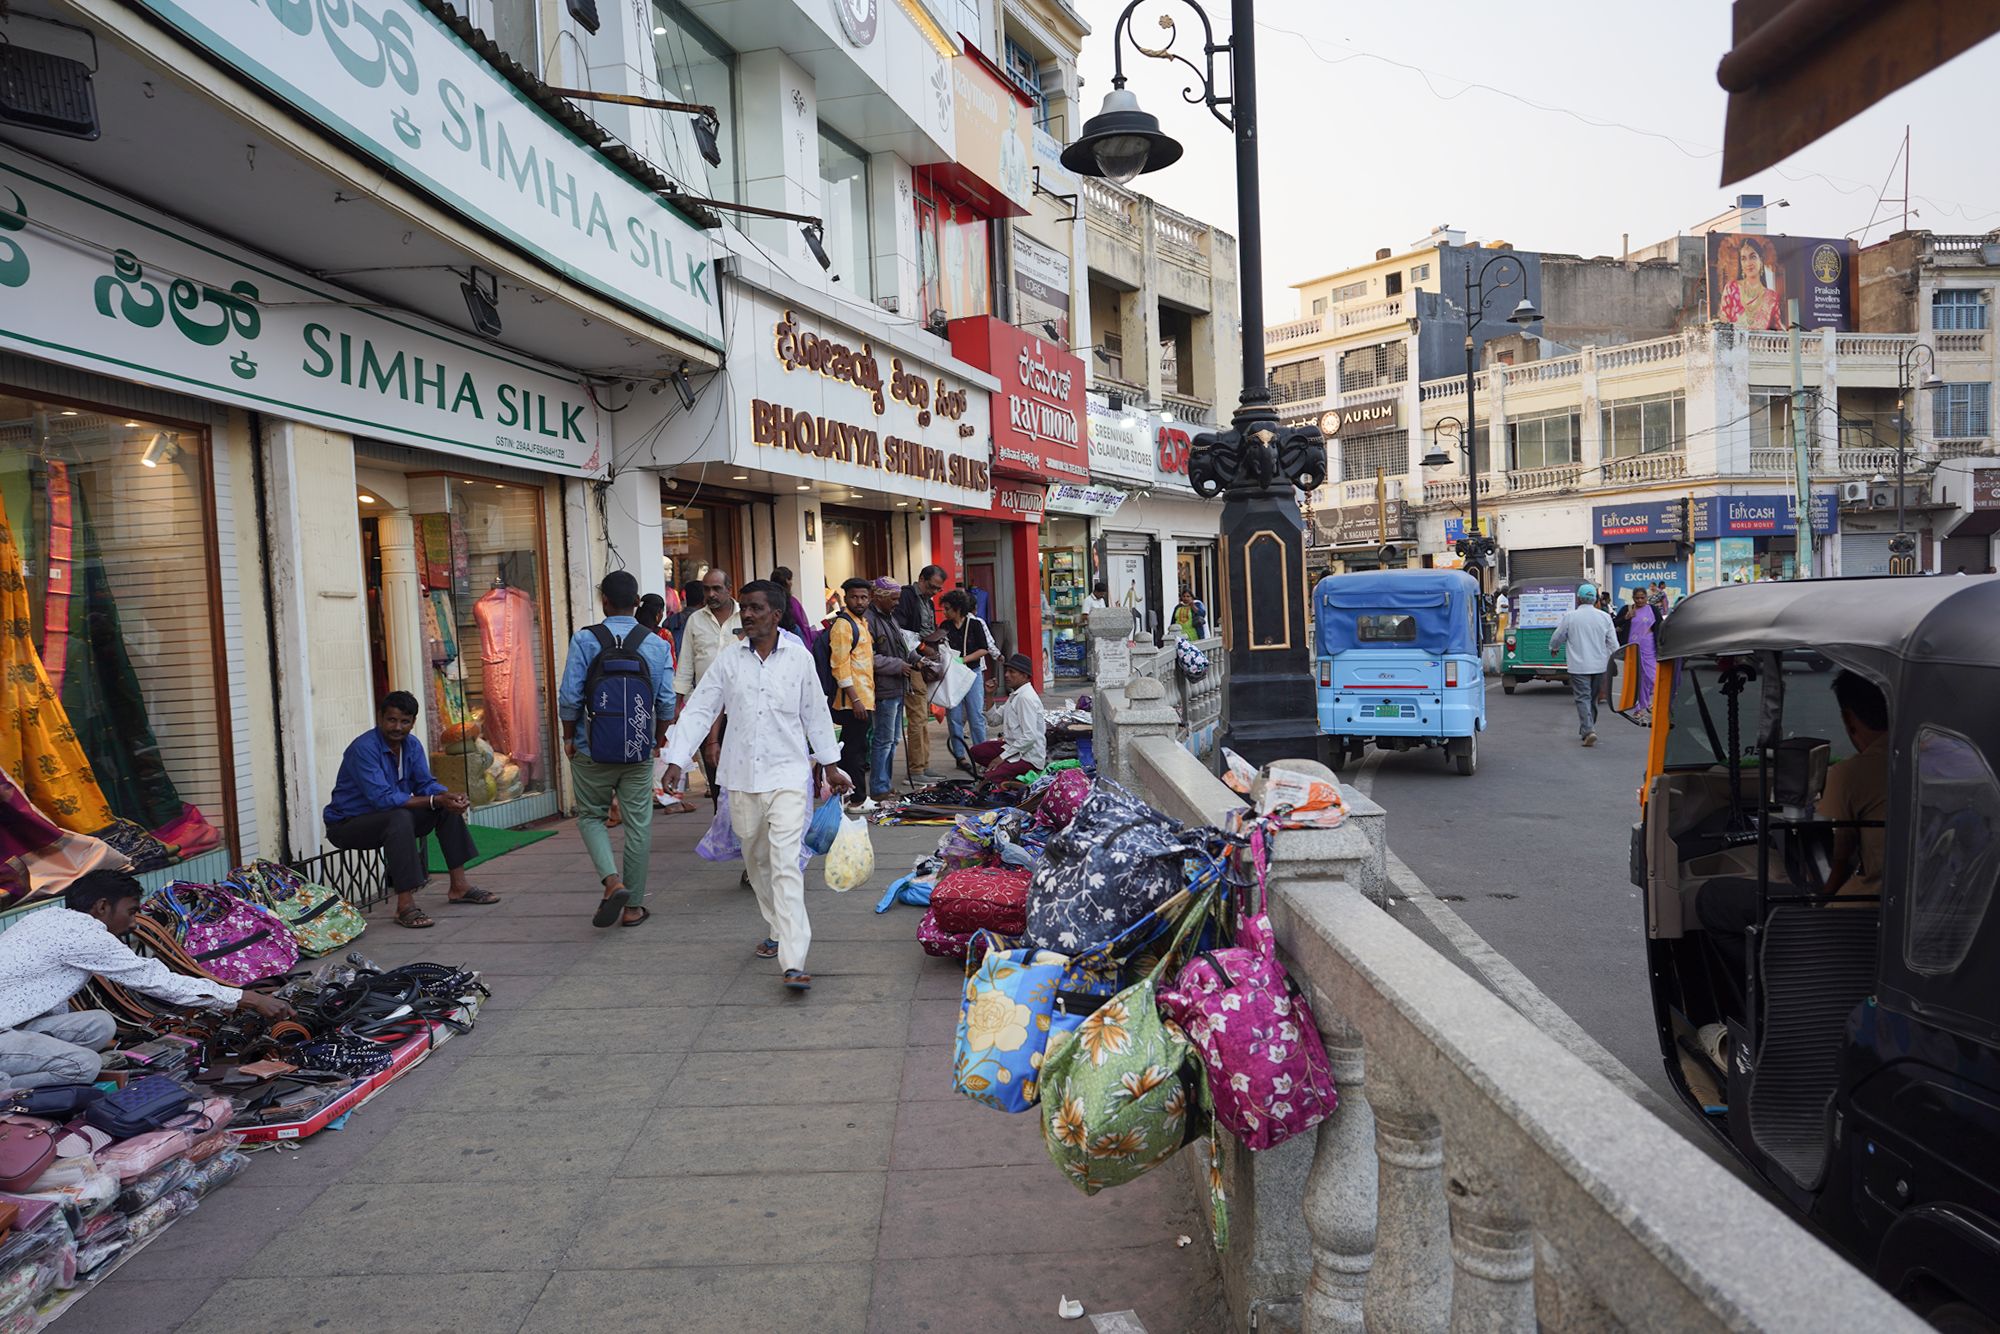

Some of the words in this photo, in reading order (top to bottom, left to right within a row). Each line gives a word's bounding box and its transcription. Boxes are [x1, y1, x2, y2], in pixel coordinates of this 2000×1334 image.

[437, 78, 618, 253] SIMHA
[627, 216, 713, 306] SILK
[1814, 286, 1840, 295] Prakash
[94, 248, 262, 379] ಸಿಲ್ಕ್
[302, 322, 484, 420] SIMHA
[497, 384, 587, 444] SILK
[1009, 394, 1078, 444] Raymond
[1344, 405, 1392, 424] AURUM
[751, 398, 881, 469] BHOJAYYA
[884, 435, 947, 483] SHILPA
[949, 454, 989, 491] SILKS
[1095, 424, 1134, 446] SREENIVASA
[1097, 442, 1129, 462] GLAMOUR
[1131, 450, 1152, 467] STORES
[1603, 528, 1625, 536] WORLD
[1625, 571, 1677, 581] EXCHANGE
[1632, 562, 1667, 570] MONEY
